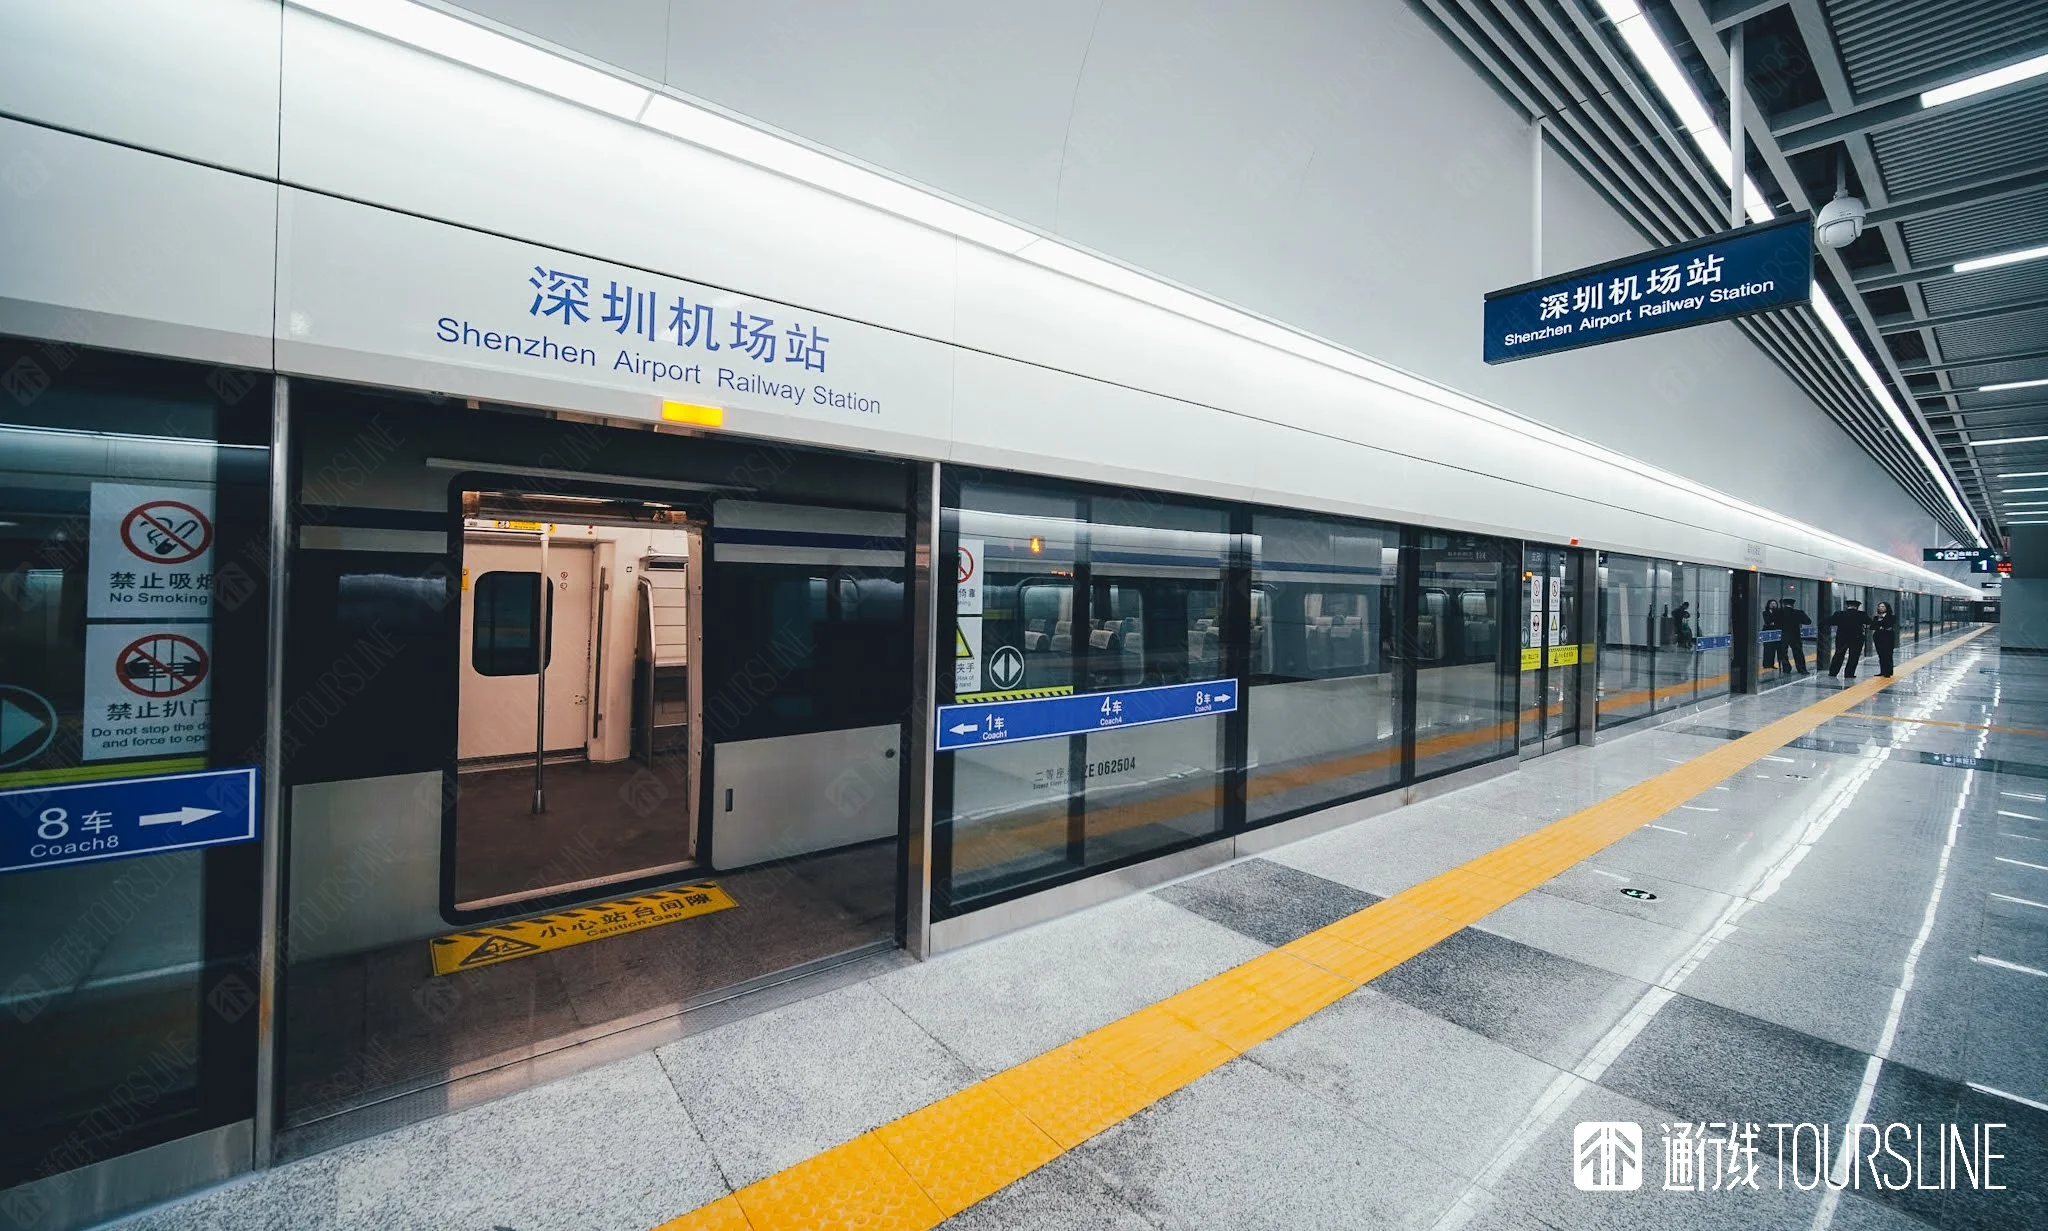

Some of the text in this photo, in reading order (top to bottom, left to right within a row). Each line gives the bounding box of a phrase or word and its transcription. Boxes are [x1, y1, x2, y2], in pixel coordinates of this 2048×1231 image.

[1539, 253, 1725, 321] 深圳机场站
[528, 265, 830, 373] 深圳机场站
[1504, 279, 1775, 346] Shenzhen Airport Railway Station
[436, 316, 882, 415] Shenzhen Airport Railway Station
[110, 592, 208, 606] No Smoking
[1100, 696, 1122, 716] 4车
[91, 728, 112, 738] Do
[116, 726, 137, 736] not
[141, 725, 170, 735] stop
[174, 722, 194, 731] the
[985, 714, 1005, 731] 1车
[1099, 715, 1123, 727] Coach4
[102, 739, 128, 748] and
[132, 736, 166, 746] force
[170, 735, 182, 743] to
[982, 728, 1008, 740] Coach1
[1097, 756, 1136, 776] 062504
[30, 834, 120, 859] Coach8
[540, 893, 713, 939] 小心站台间隙
